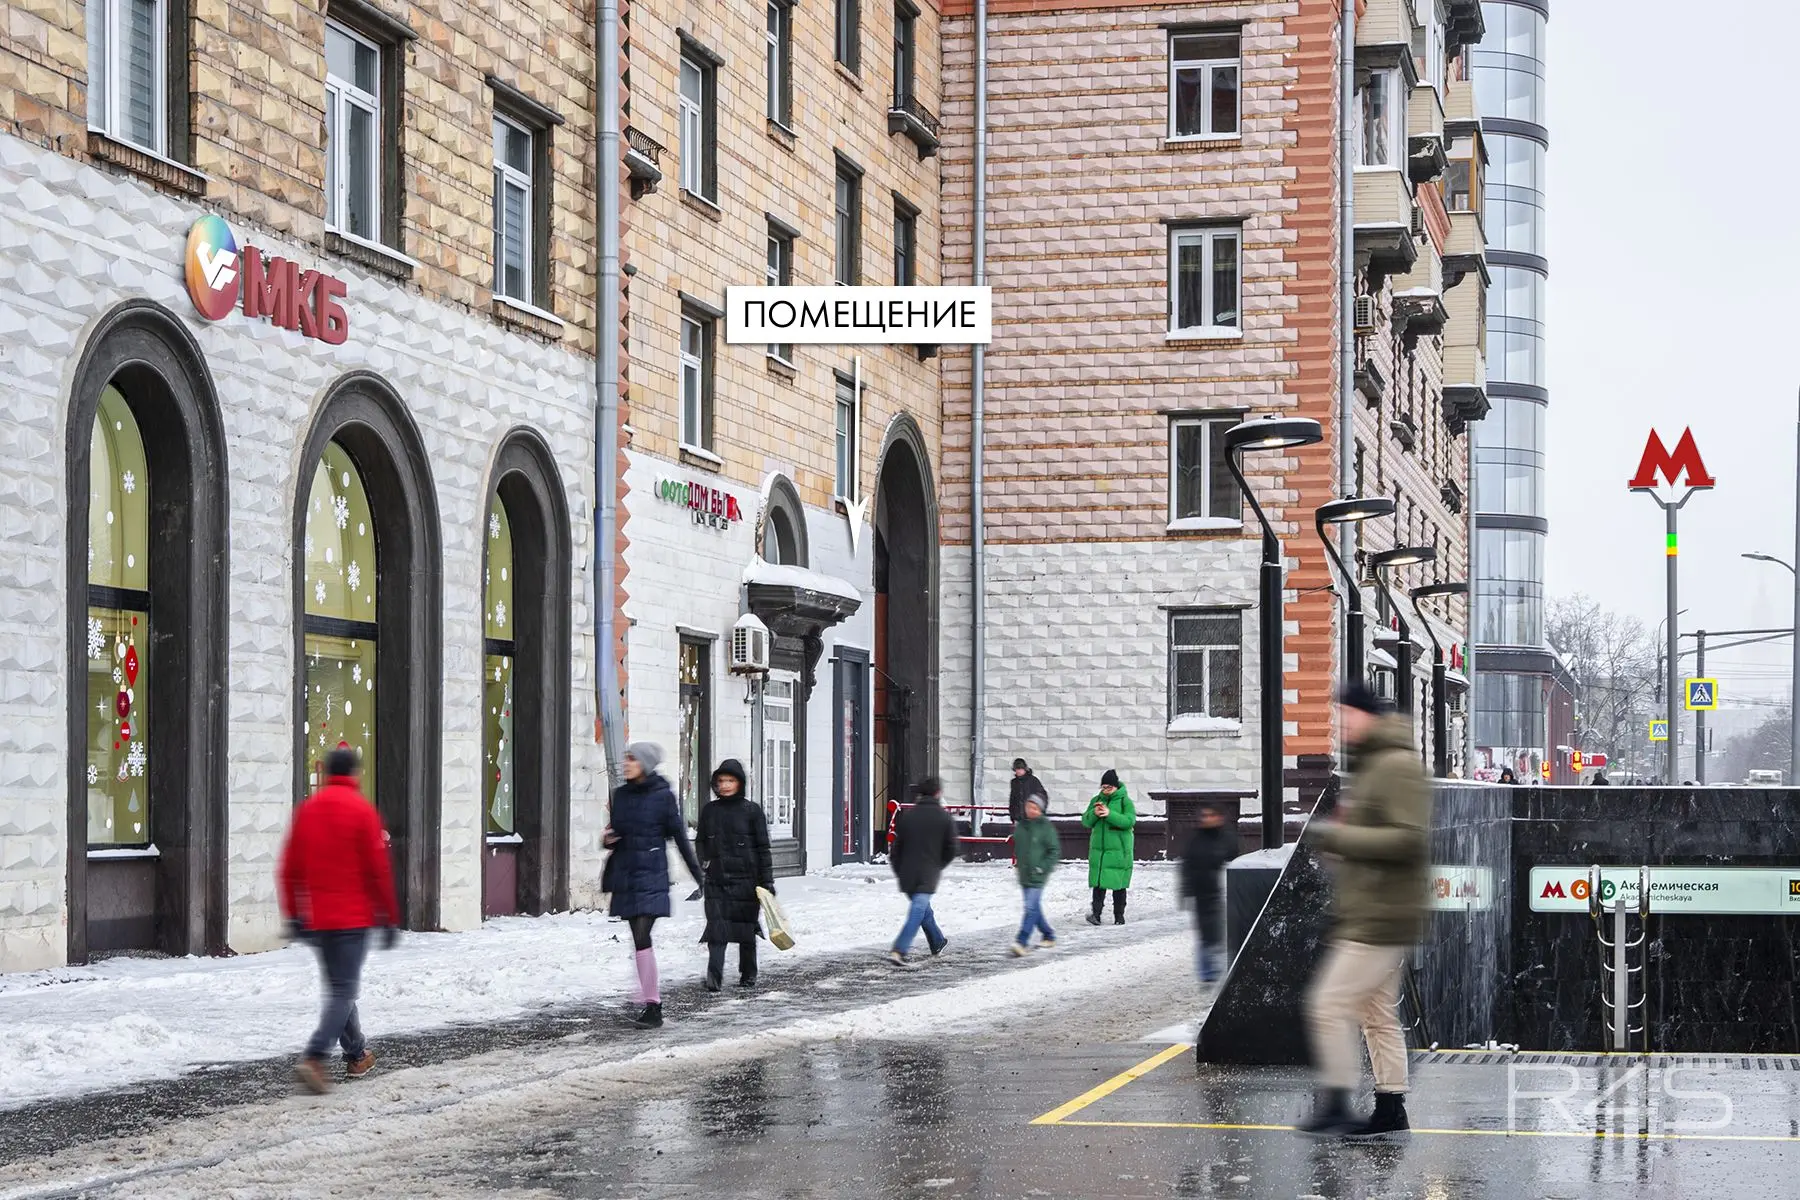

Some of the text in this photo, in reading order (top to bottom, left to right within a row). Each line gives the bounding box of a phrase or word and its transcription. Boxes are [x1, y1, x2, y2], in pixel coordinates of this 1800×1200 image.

[243, 245, 349, 345] МКБ
[1628, 425, 1716, 487] М
[1576, 883, 1586, 896] 6
[1620, 880, 1719, 891] Акаемическая
[1620, 893, 1692, 902] Akaicheskaya
